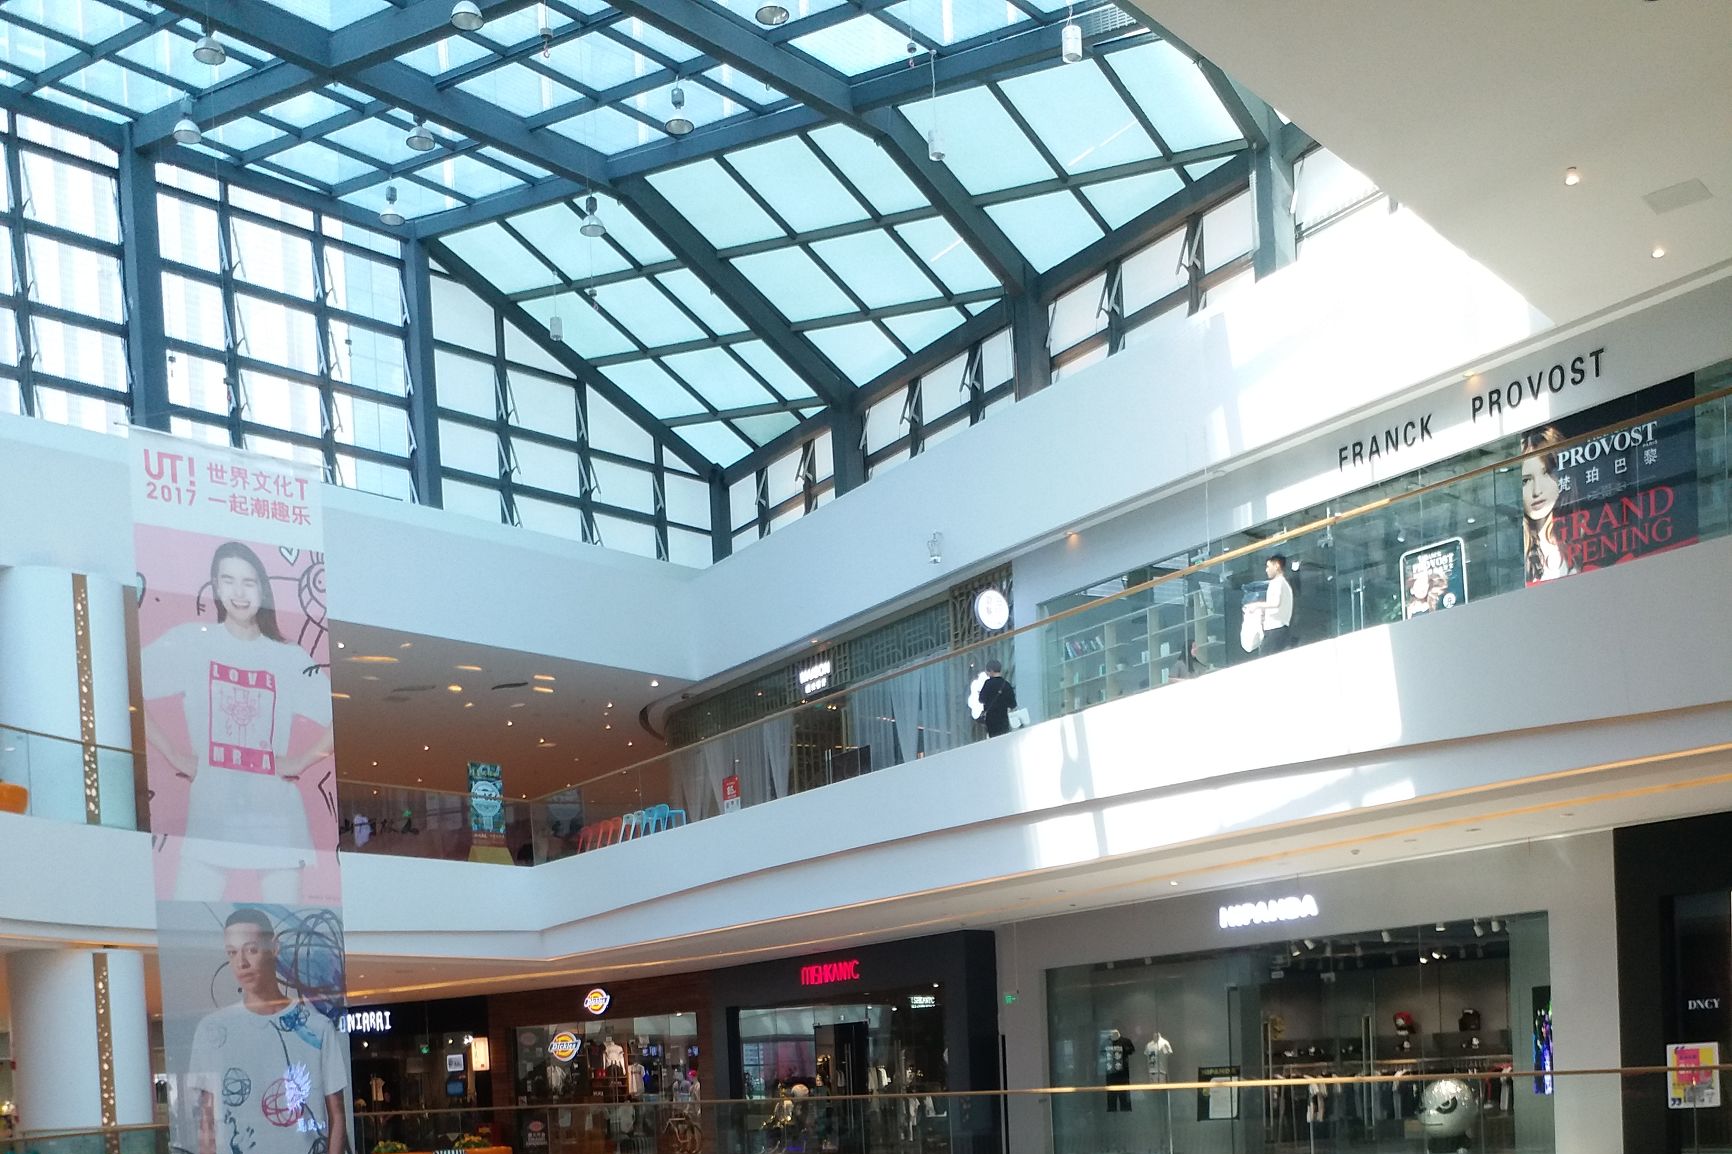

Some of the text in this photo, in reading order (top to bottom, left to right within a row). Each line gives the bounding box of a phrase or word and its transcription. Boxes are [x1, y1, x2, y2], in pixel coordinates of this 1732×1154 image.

[1338, 347, 1606, 472] FRANCK PROVOST
[1557, 420, 1658, 472] PROVOST
[142, 448, 197, 487] UT!
[206, 461, 310, 502] 世界文化T
[146, 481, 197, 507] 2017
[207, 493, 312, 526] 一起潮趣乐
[1546, 485, 1675, 546] GRAND
[212, 664, 273, 689] LOVE
